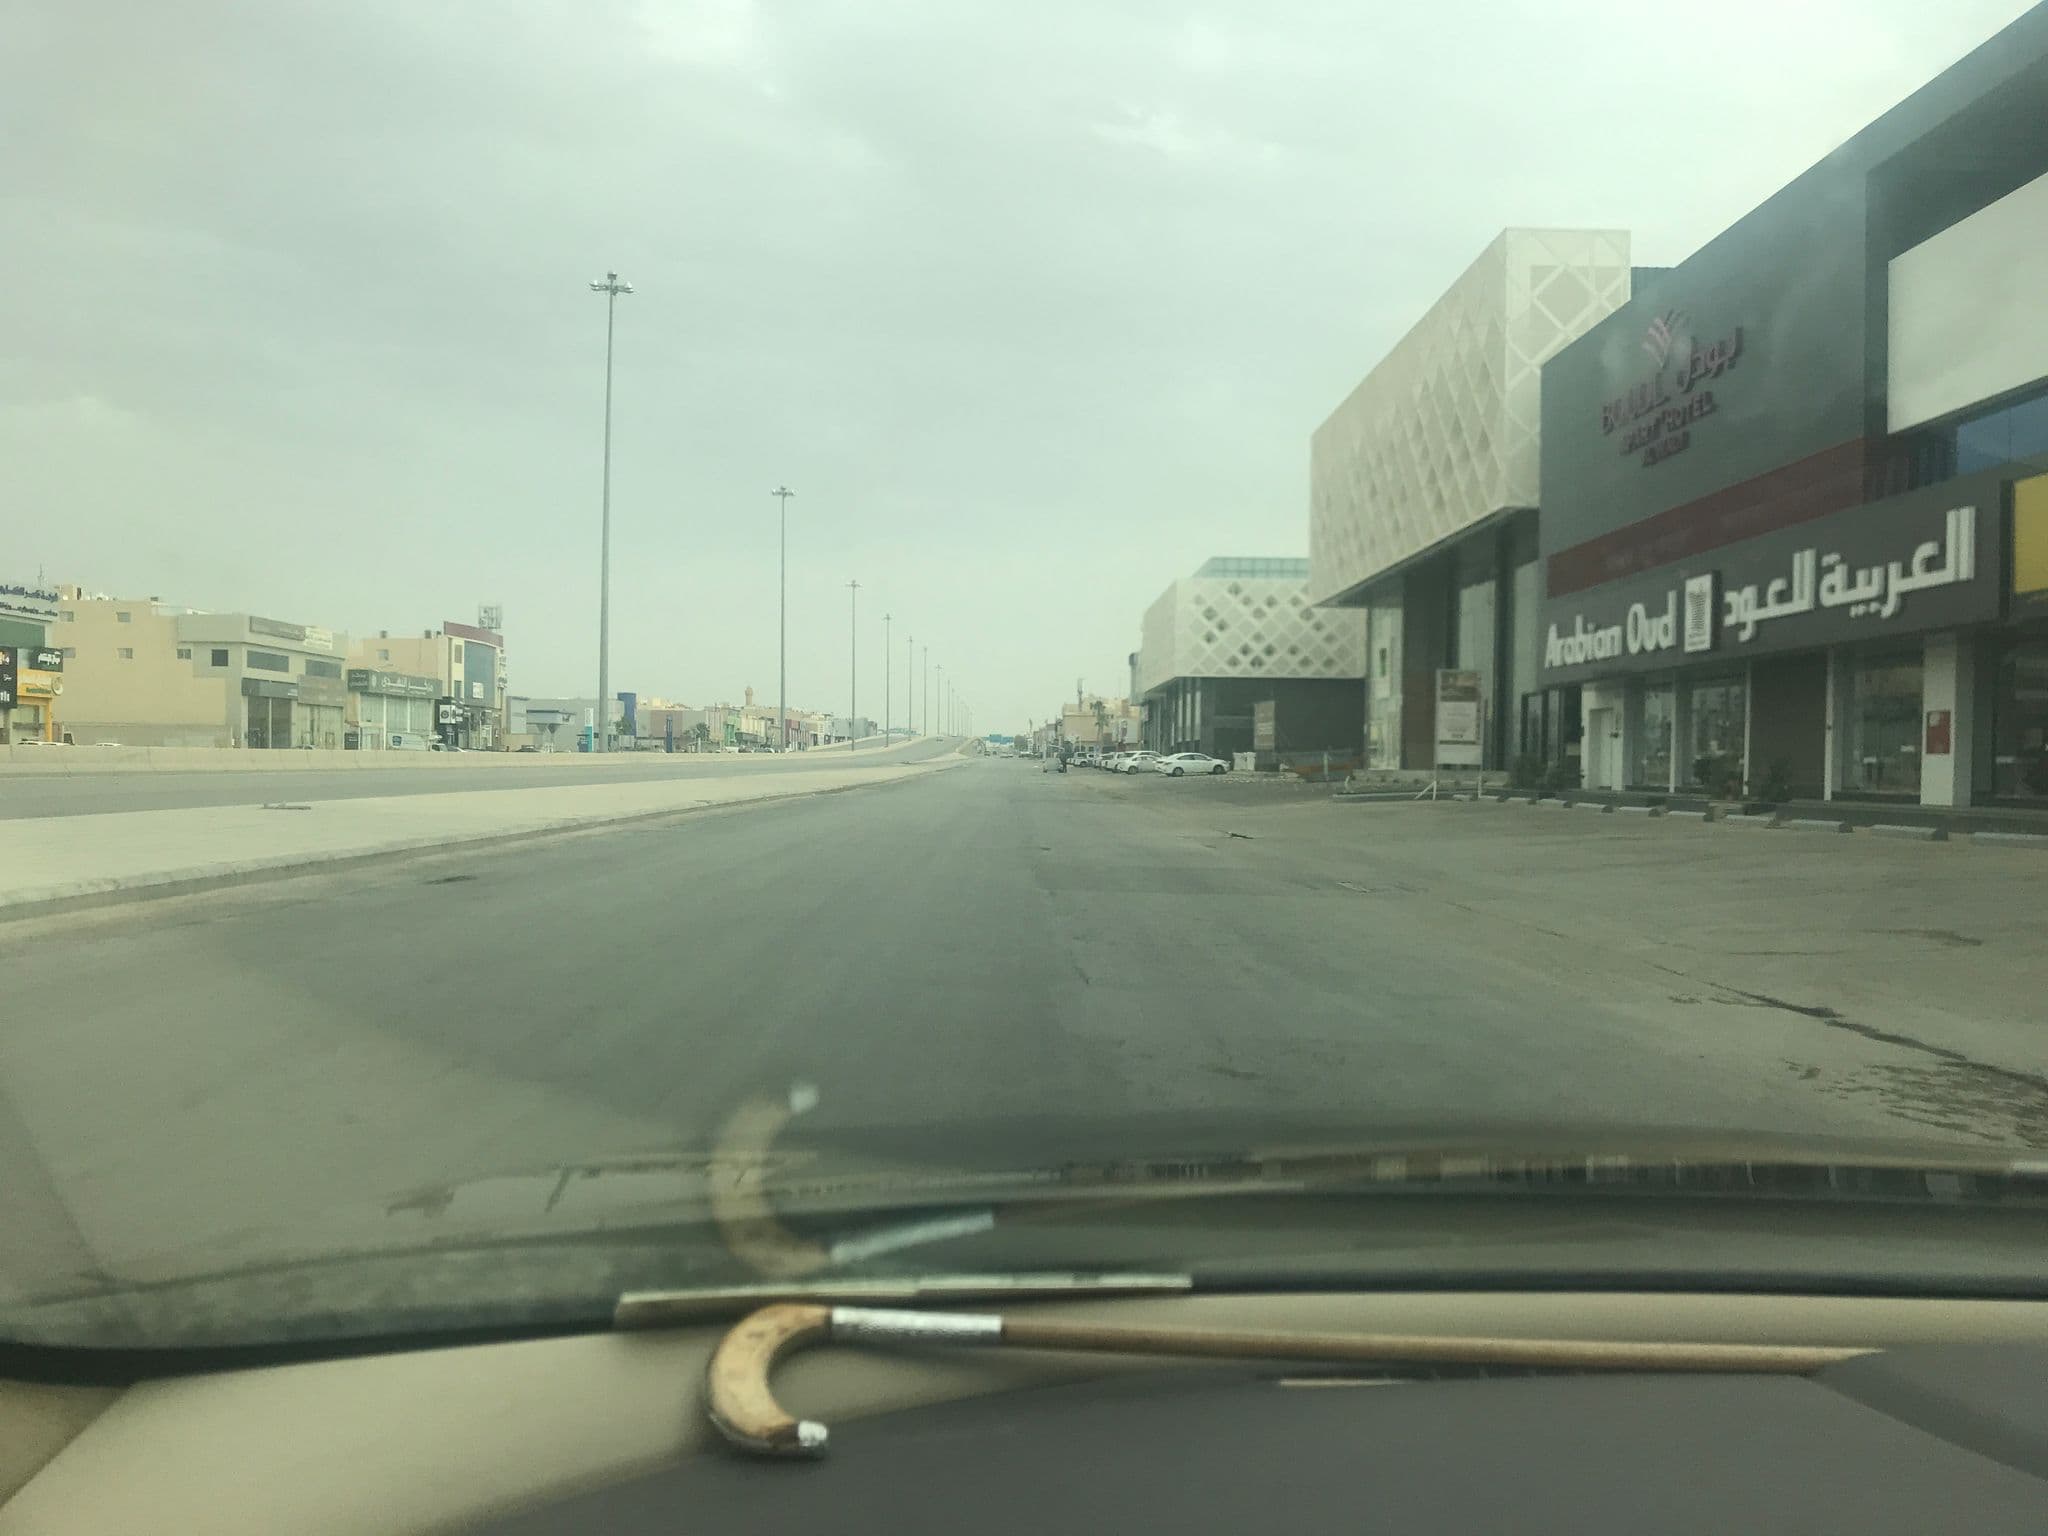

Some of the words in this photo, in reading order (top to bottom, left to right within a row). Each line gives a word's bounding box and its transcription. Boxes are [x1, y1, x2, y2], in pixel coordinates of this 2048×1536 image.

[1723, 547, 1816, 642] للعود
[1820, 505, 1975, 618] العربية
[1545, 614, 1622, 668] Arabian
[1627, 590, 1677, 655] Oud
